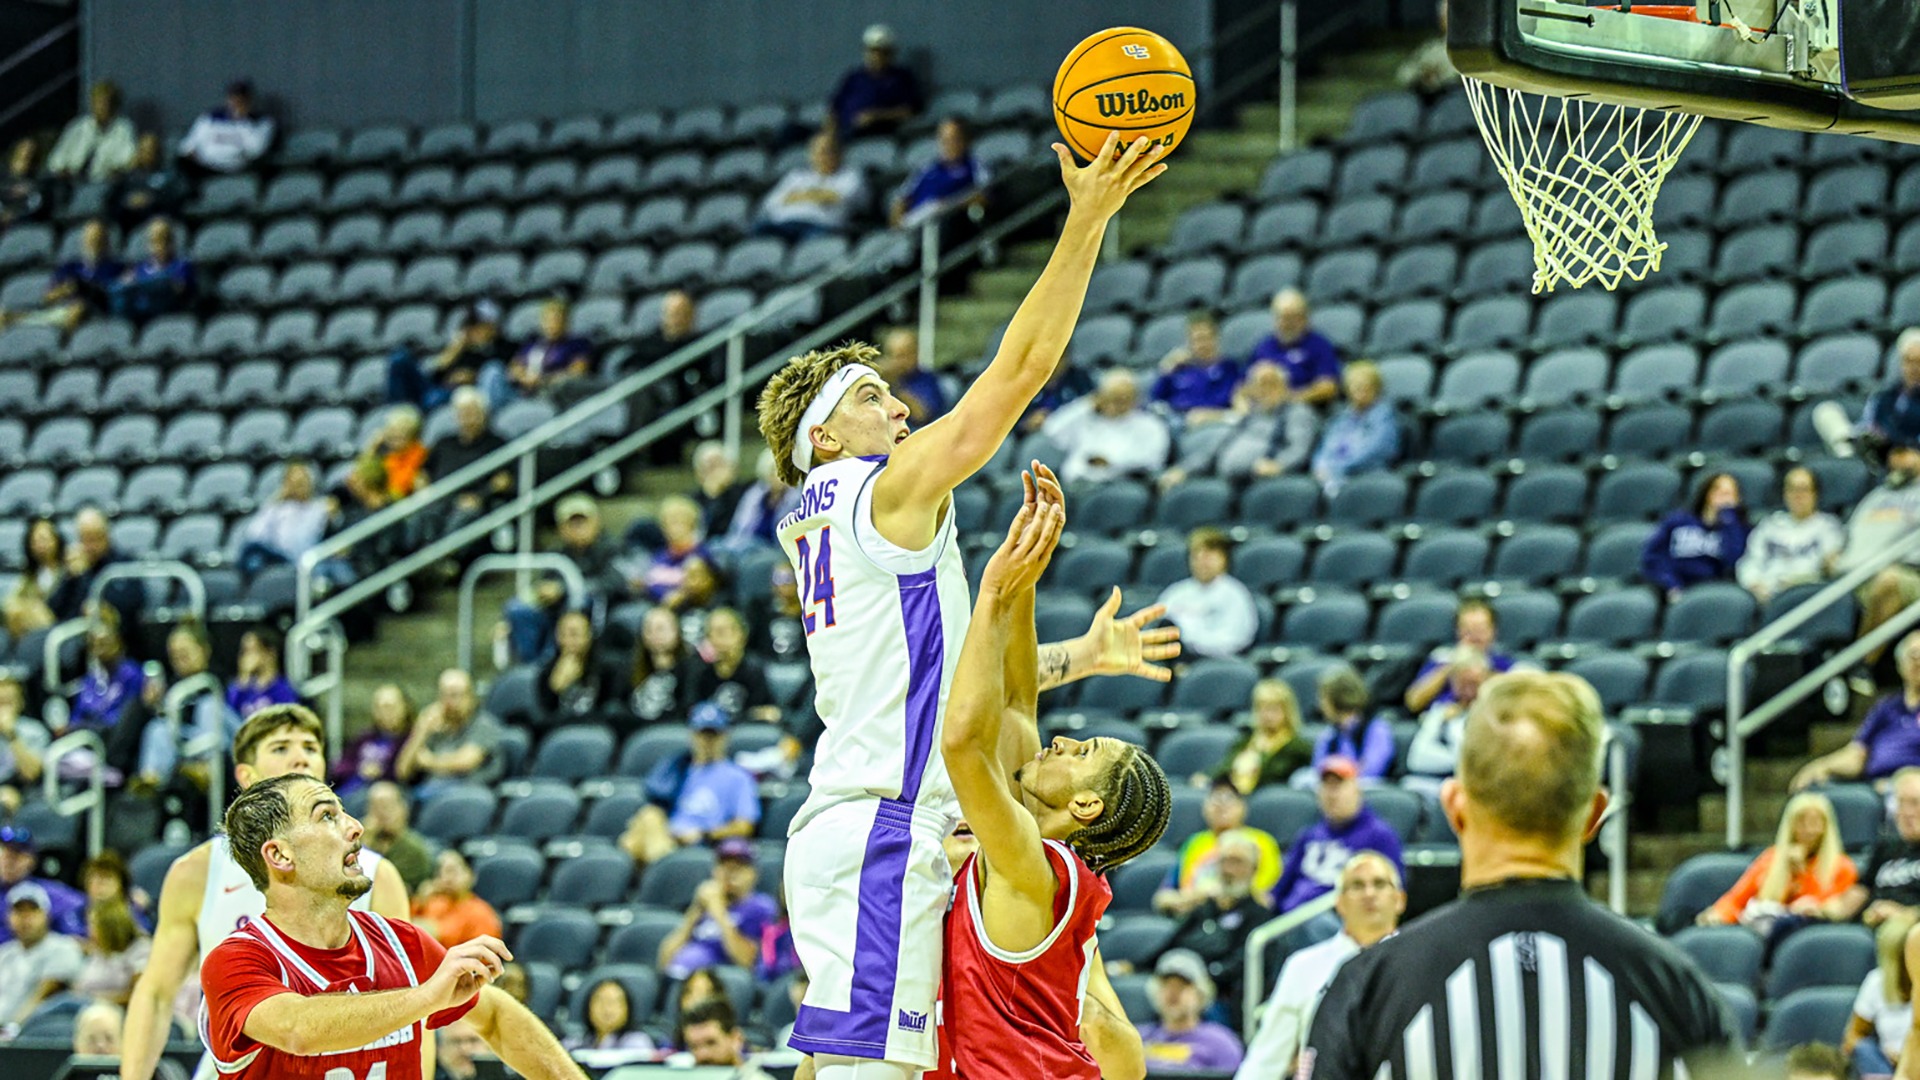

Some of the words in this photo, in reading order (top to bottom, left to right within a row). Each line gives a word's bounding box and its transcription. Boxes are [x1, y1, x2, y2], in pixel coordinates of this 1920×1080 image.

[1095, 88, 1185, 118] Wilson
[795, 526, 836, 637] 24
[898, 1008, 928, 1031] VALLEY
